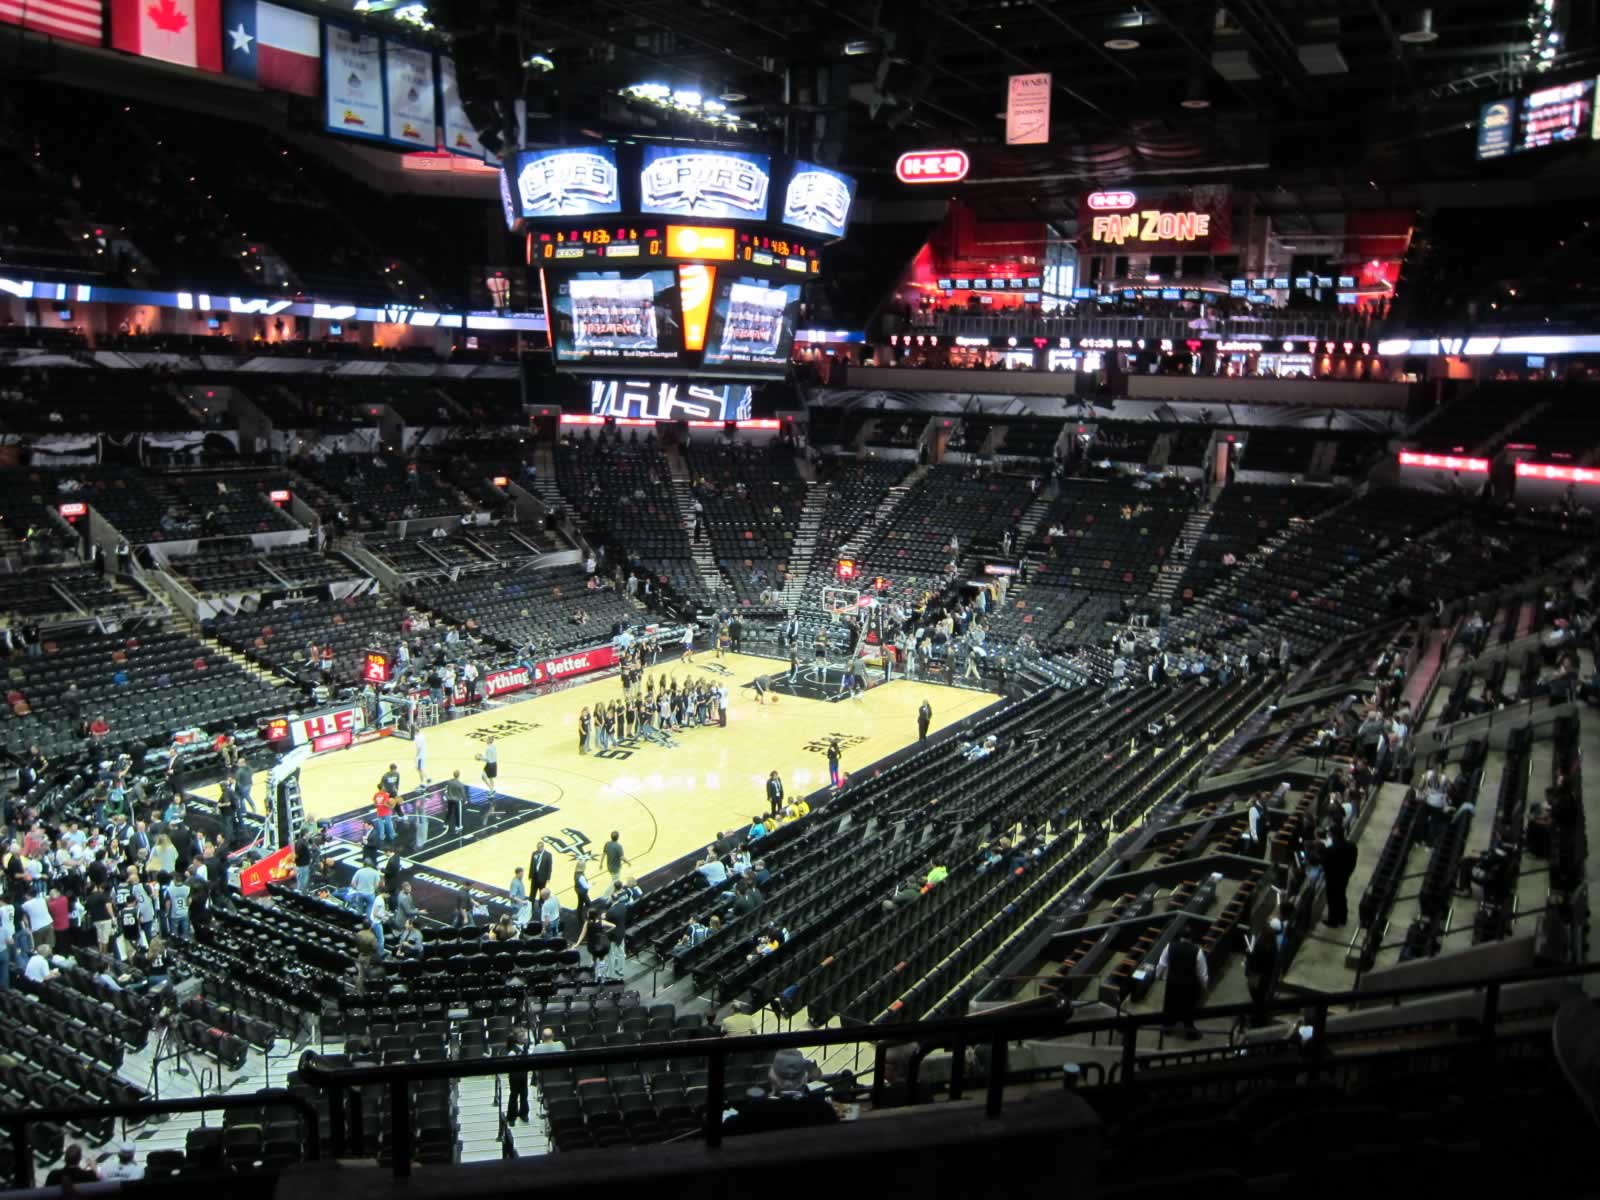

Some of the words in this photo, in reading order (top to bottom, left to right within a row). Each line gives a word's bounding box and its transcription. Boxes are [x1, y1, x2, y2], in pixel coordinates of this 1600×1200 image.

[1092, 213, 1139, 245] FAN
[1140, 210, 1210, 241] ZONE
[368, 664, 384, 679] 24
[546, 655, 590, 676] Better.
